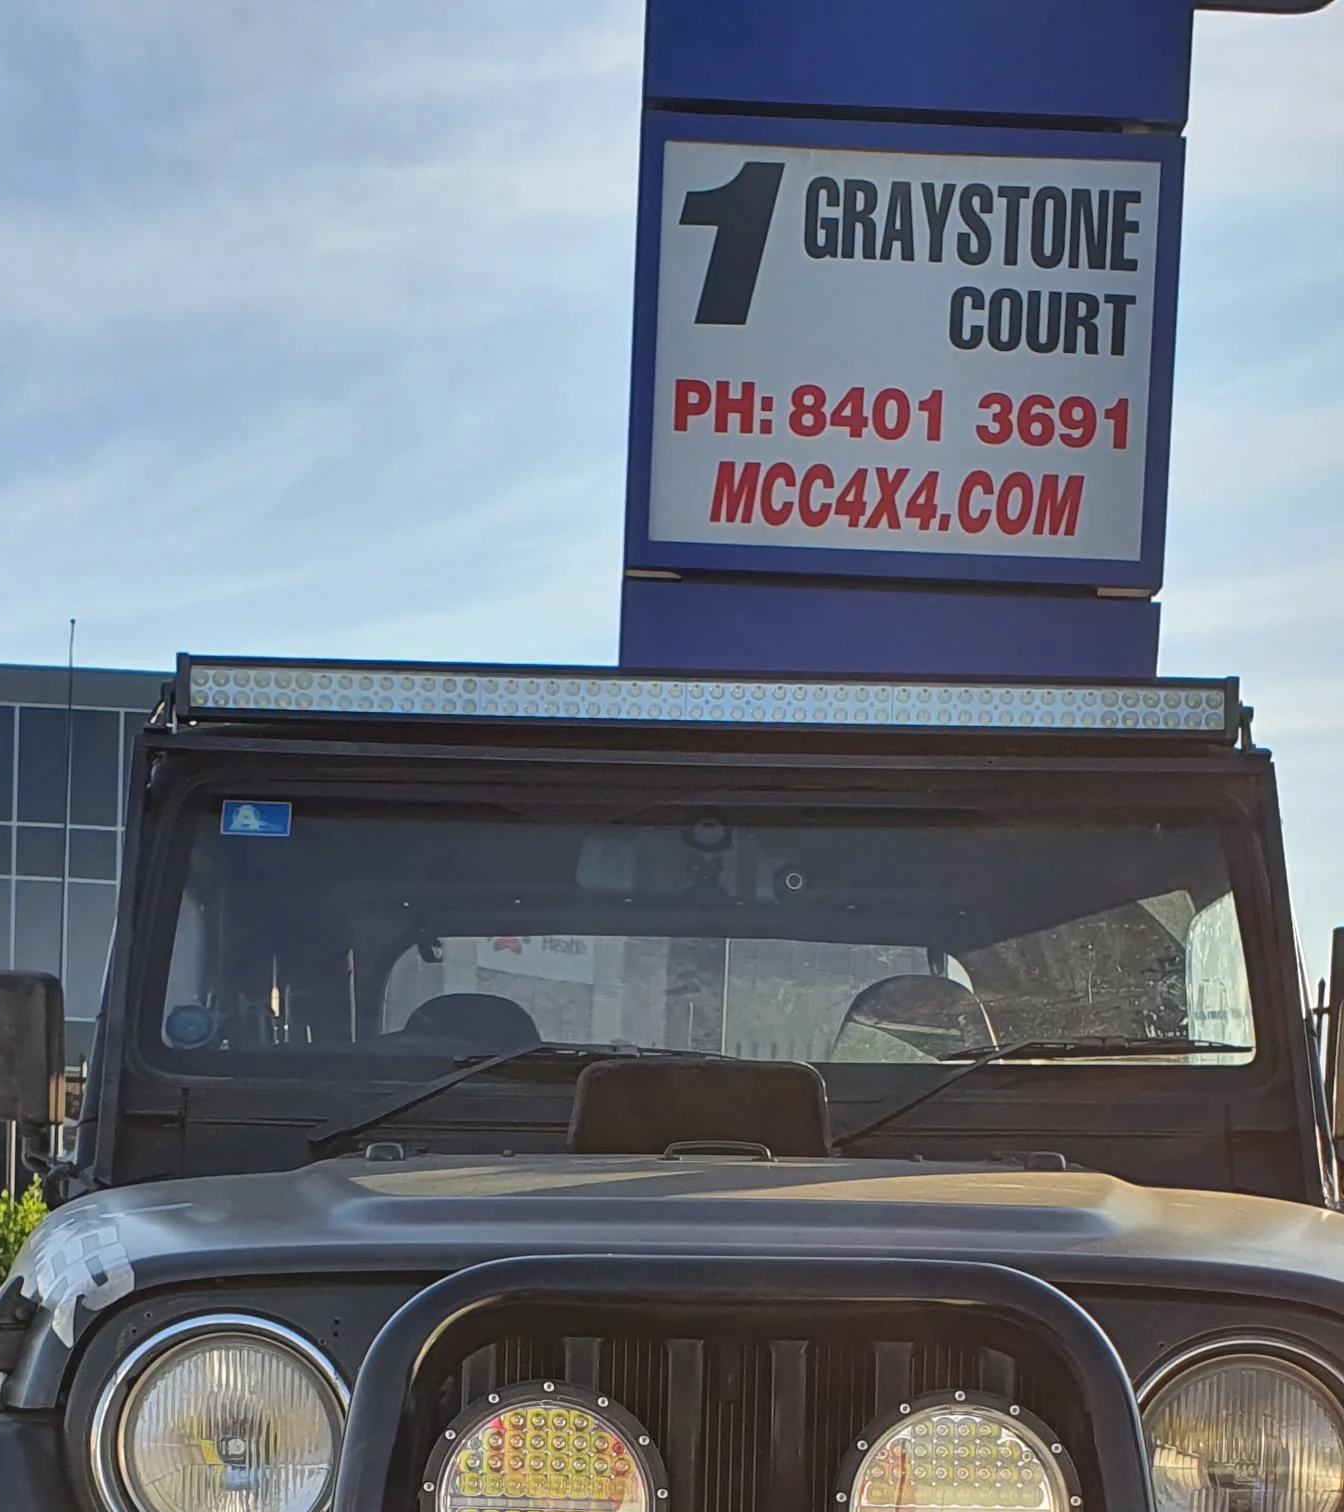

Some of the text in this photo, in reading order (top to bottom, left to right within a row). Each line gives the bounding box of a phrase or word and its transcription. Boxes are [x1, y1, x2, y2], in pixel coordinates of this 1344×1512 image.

[678, 161, 1142, 325] 1 GRAYSTONE
[948, 286, 1137, 356] COURT
[673, 379, 1129, 450] PH: 8401 3691
[709, 460, 1086, 537] MCC4X4.COM
